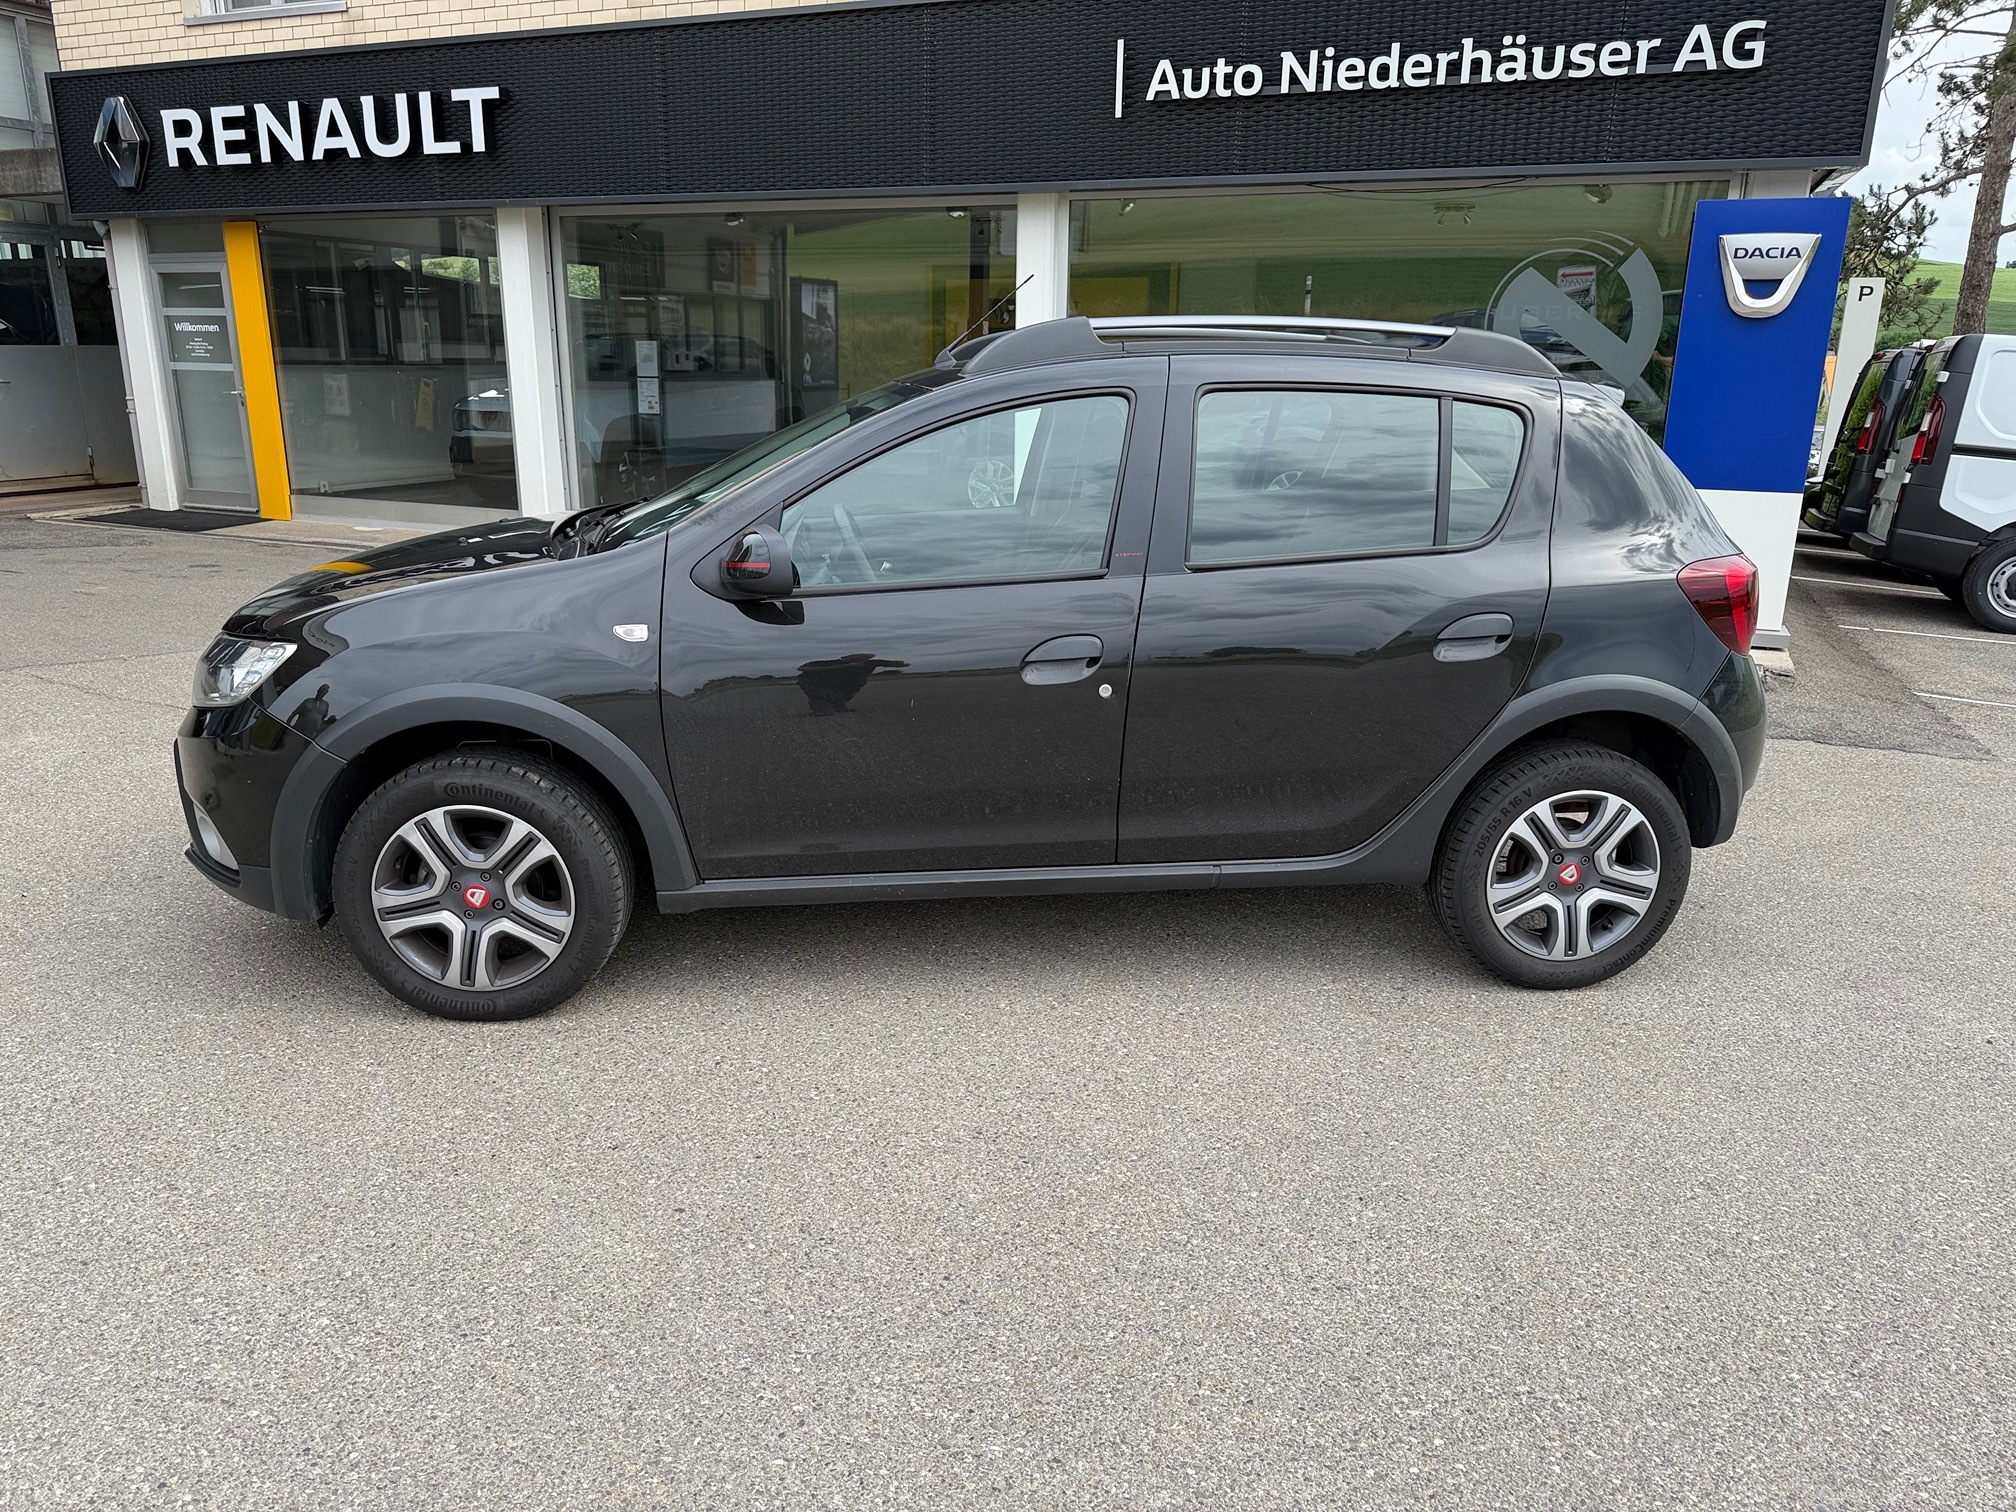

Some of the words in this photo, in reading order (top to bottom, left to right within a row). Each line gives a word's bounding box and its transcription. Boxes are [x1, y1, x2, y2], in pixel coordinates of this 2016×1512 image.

[1146, 58, 1263, 101] Auto
[1280, 34, 1662, 94] Niederhäuser
[1672, 20, 1768, 72] AG
[160, 86, 500, 167] RENAULT
[1733, 247, 1802, 259] DACIA
[1858, 286, 1874, 301] P
[173, 322, 220, 332] Willkommen
[443, 782, 536, 817] Continental
[1474, 816, 1502, 857] 205/55
[1500, 807, 1510, 817] R
[1509, 795, 1522, 809] 16
[1523, 787, 1532, 798] V
[1632, 783, 1681, 842] Continental
[1602, 899, 1677, 973] PremiumContact
[410, 985, 498, 1014] Continental
